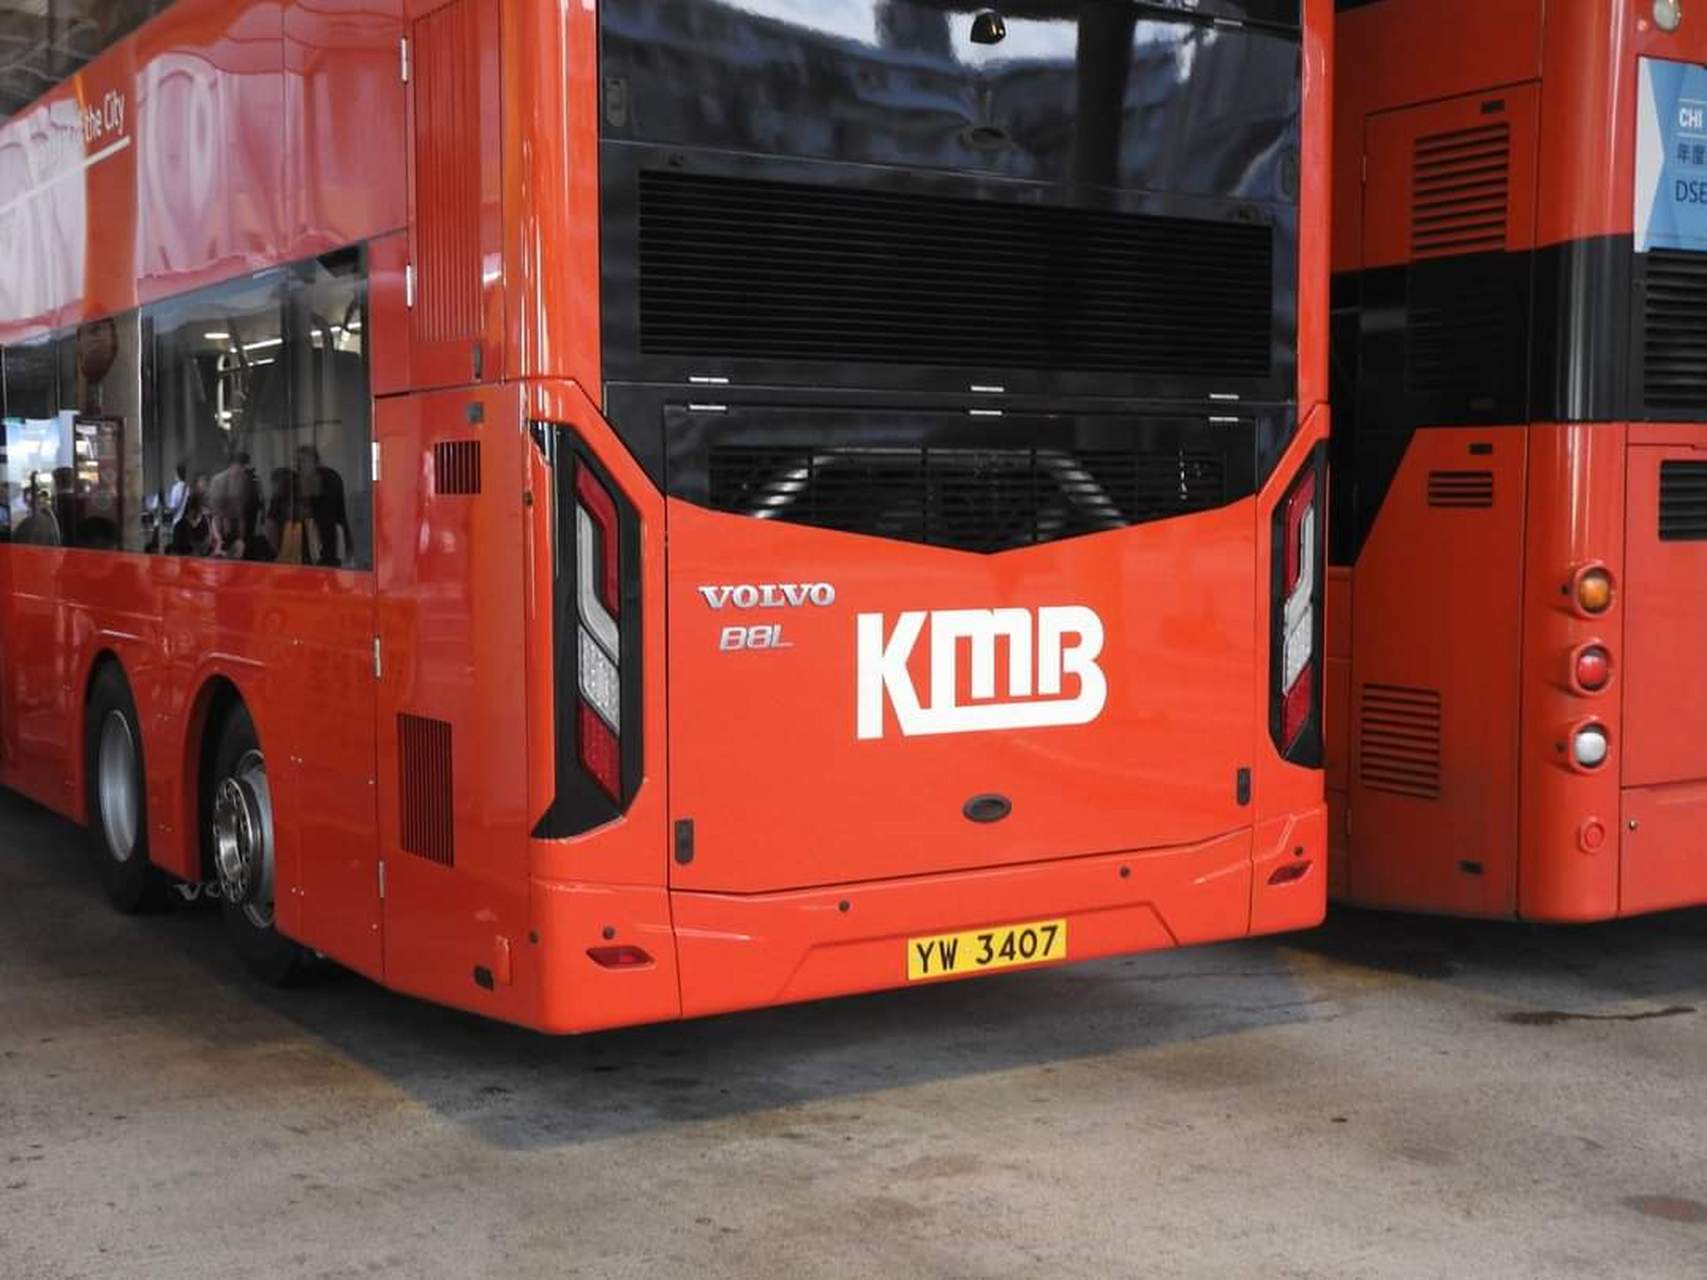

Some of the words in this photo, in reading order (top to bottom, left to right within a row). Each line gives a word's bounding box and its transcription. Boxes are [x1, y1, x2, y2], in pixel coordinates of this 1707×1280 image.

[103, 89, 126, 136] City
[698, 582, 836, 609] VOLVO
[719, 624, 794, 651] B8L
[856, 605, 1107, 740] KMB
[916, 938, 958, 973] YW
[975, 925, 1059, 965] 3407
